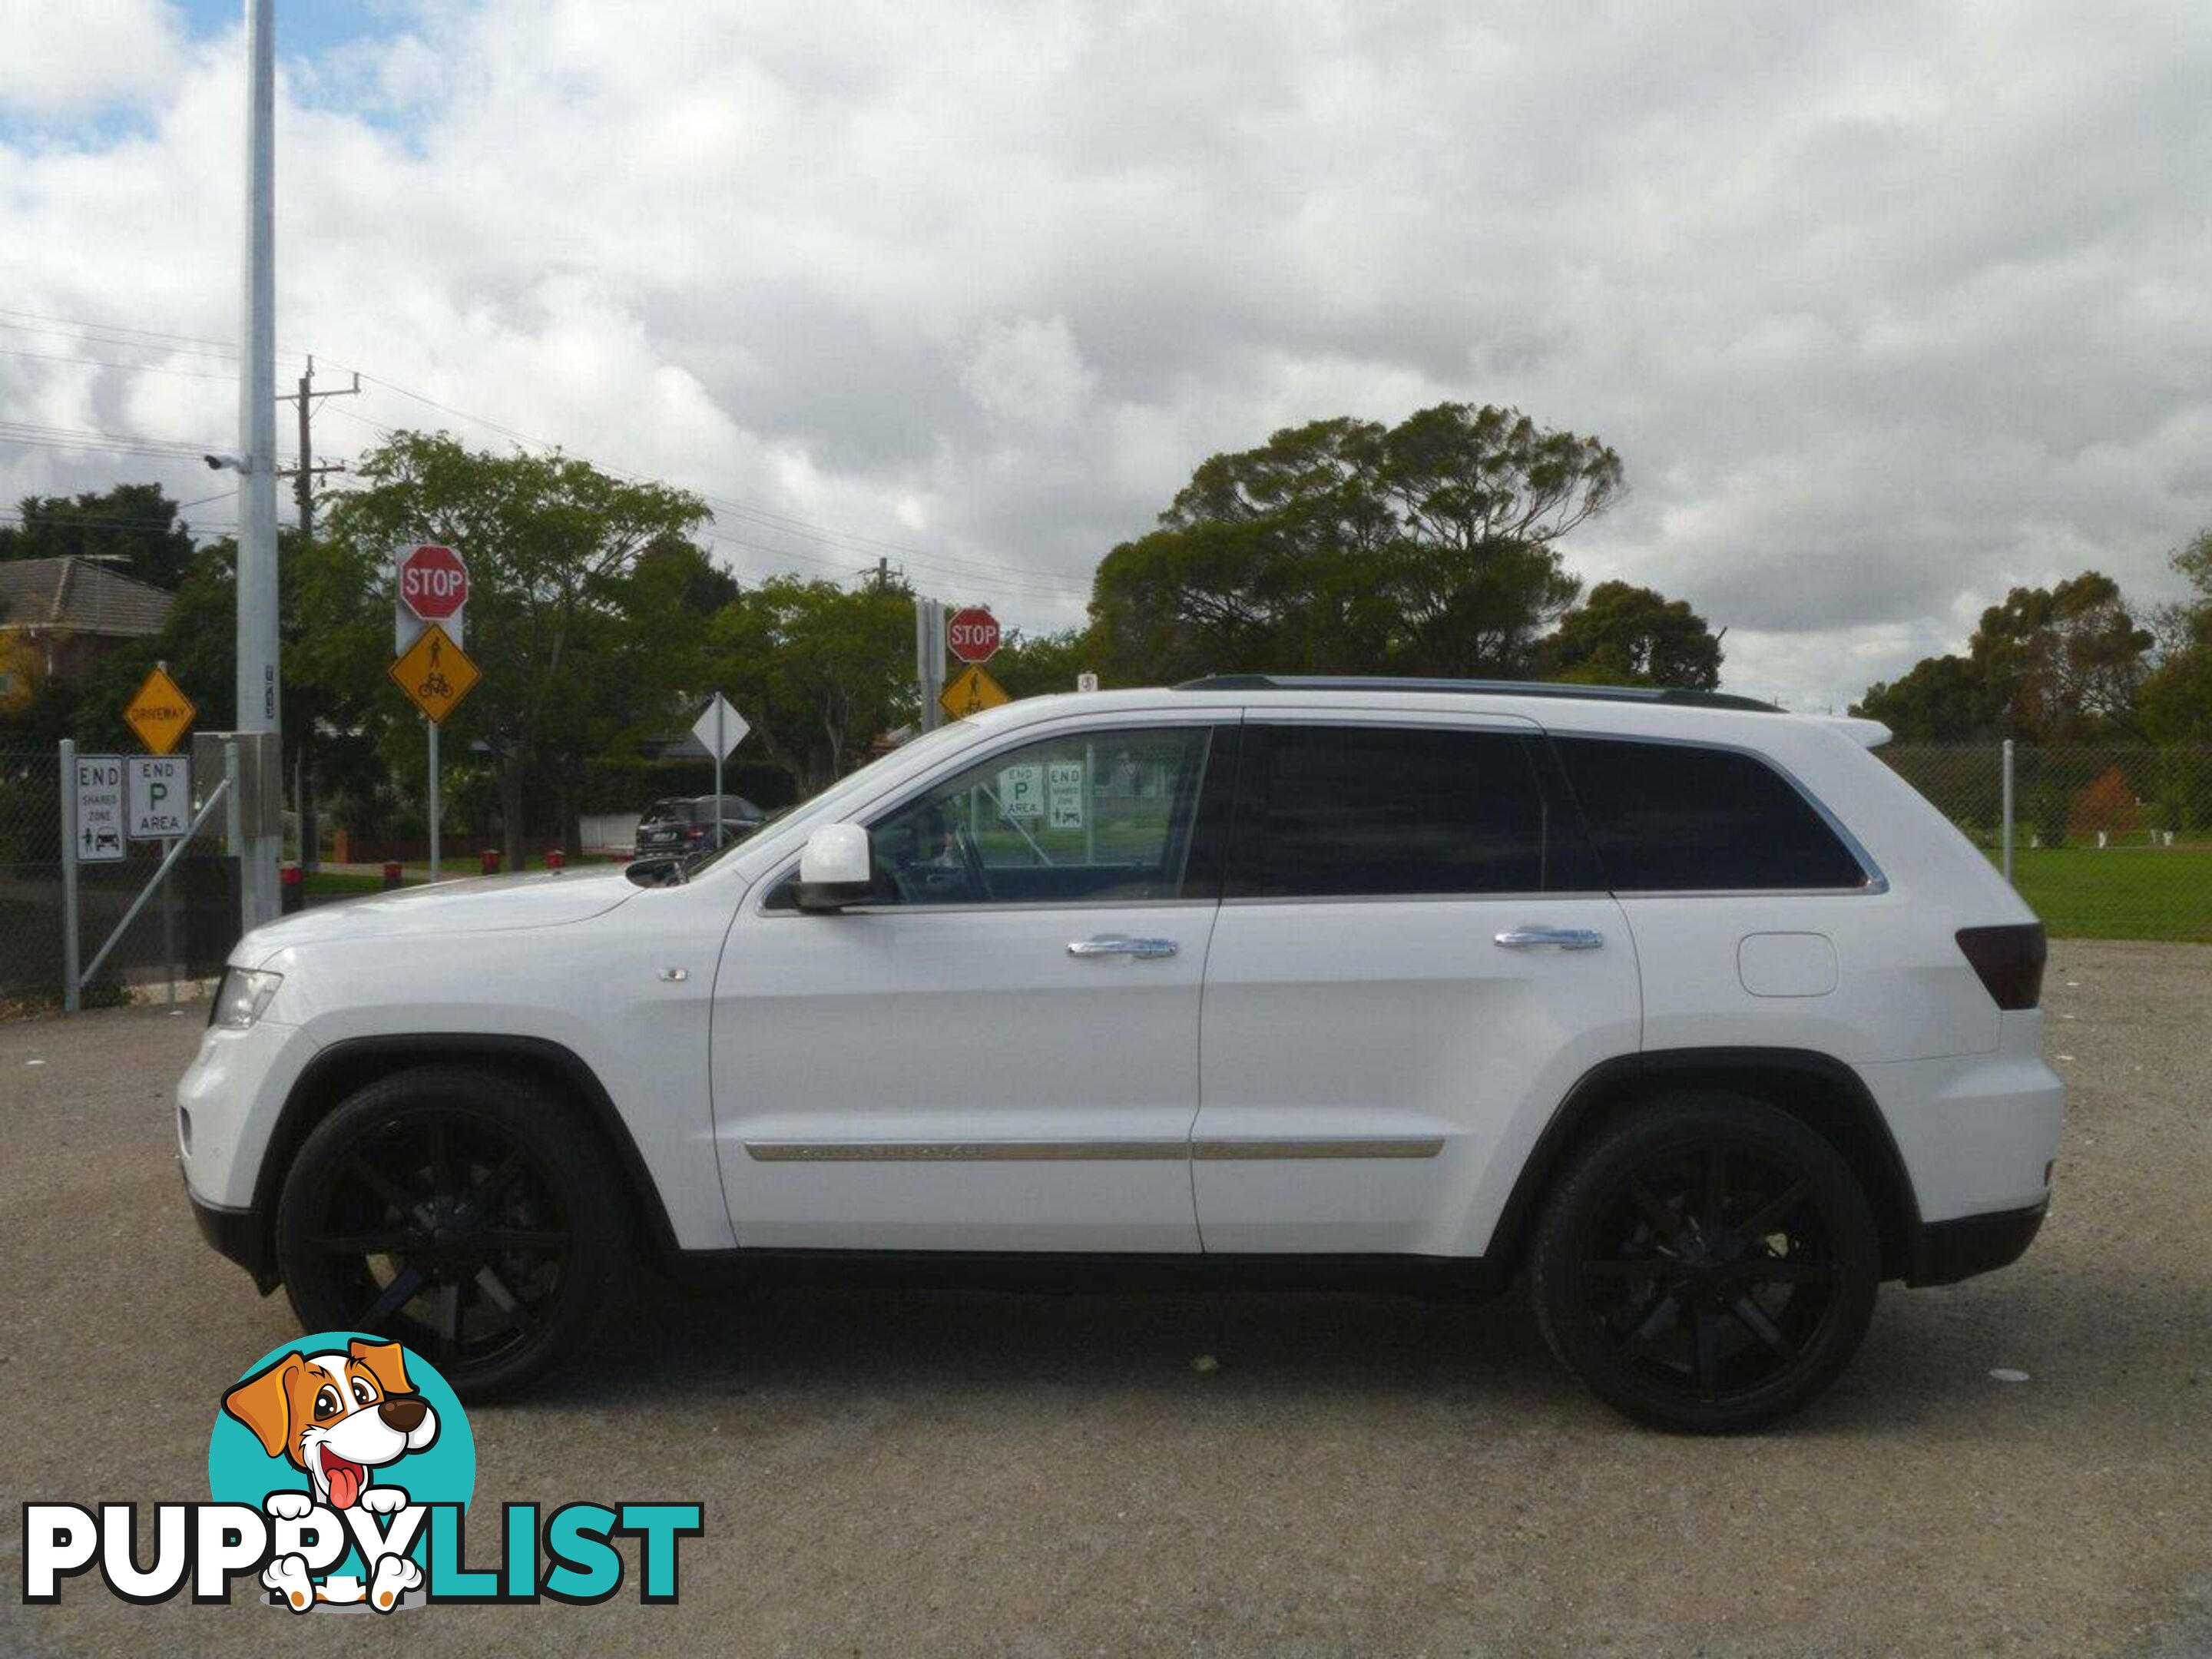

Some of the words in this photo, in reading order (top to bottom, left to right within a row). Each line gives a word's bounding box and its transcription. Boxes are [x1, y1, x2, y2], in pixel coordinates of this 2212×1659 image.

[406, 568, 463, 596] STOP
[952, 624, 996, 644] STOP
[80, 768, 118, 786] END
[143, 763, 174, 777] END
[1051, 770, 1079, 783] END
[150, 782, 167, 812] P
[1015, 783, 1028, 800] P
[141, 816, 179, 830] AREA
